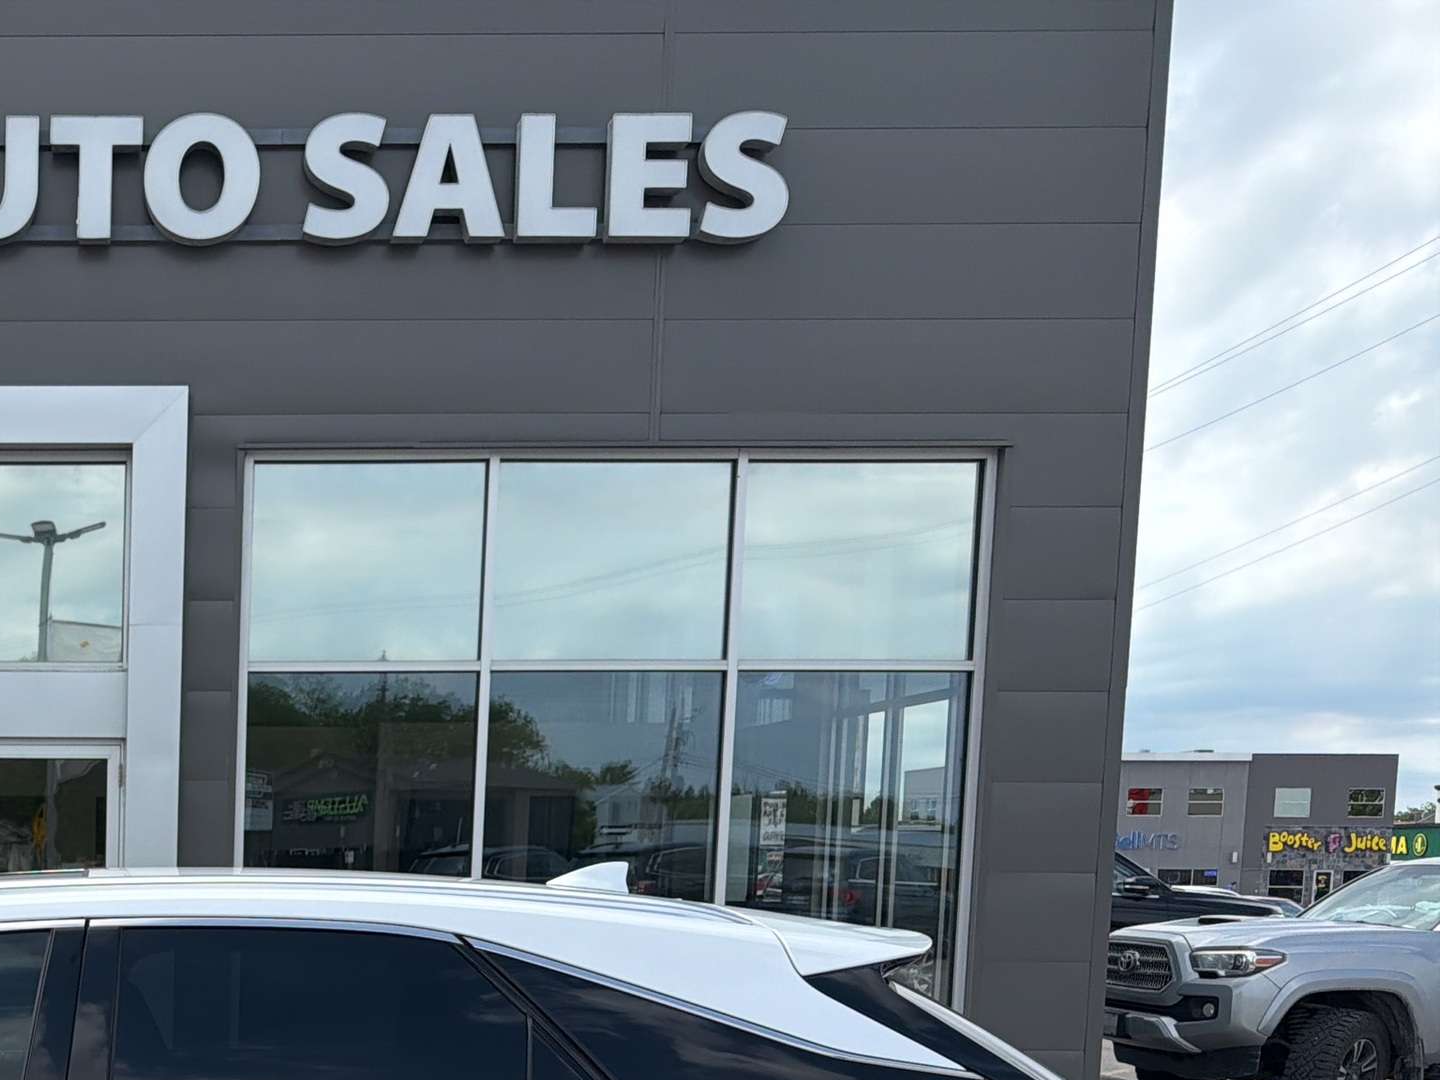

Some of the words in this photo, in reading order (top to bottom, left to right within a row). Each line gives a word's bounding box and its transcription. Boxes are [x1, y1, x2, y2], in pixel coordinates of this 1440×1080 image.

[302, 112, 790, 245] SALES
[1268, 831, 1322, 853] Booster
[1344, 832, 1387, 853] Juice
